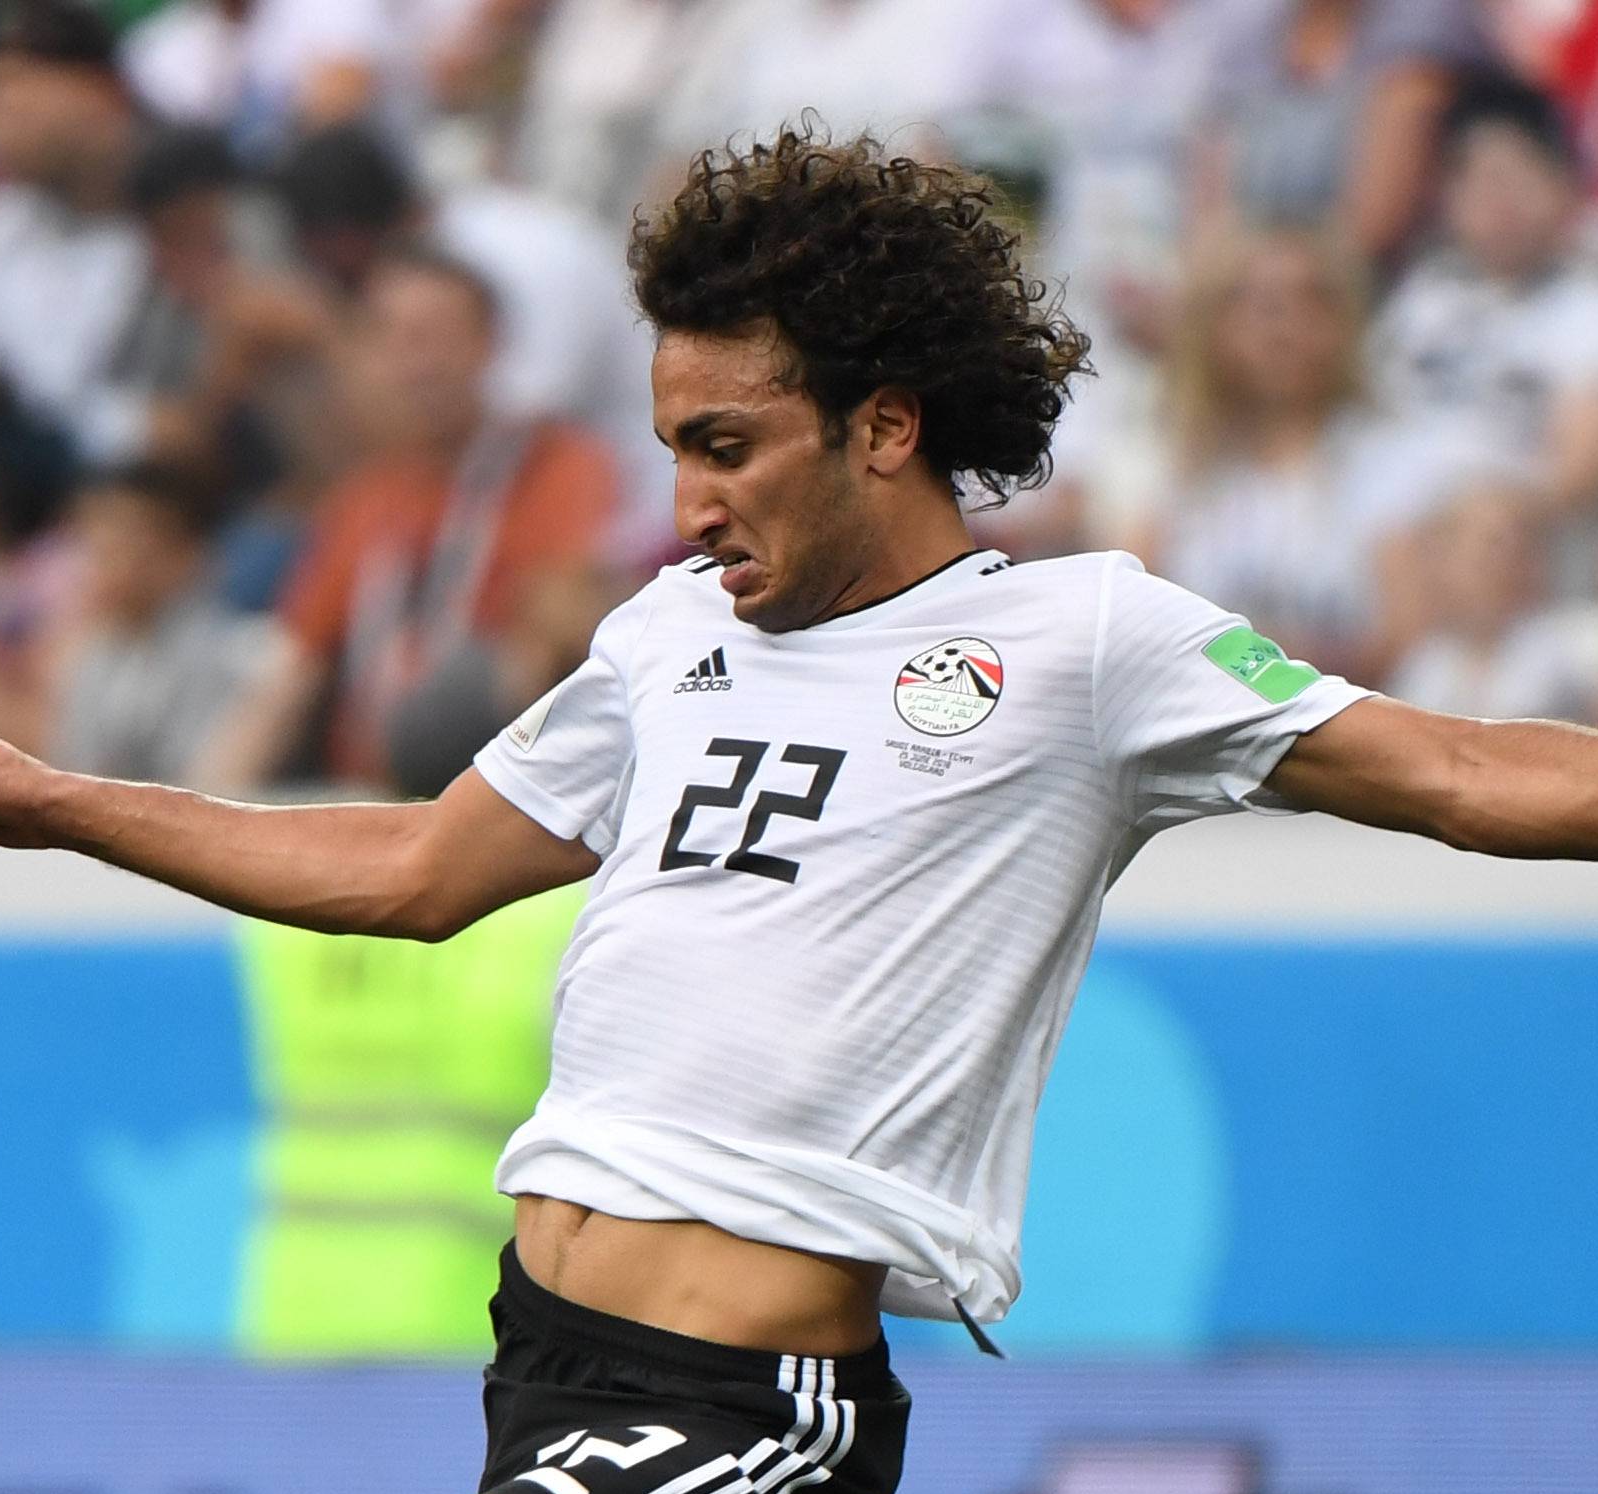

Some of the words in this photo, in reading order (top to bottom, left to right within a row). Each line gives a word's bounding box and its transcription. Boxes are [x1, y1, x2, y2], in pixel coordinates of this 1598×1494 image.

[673, 675, 733, 694] adidas
[907, 711, 948, 730] EGYPTIAN
[660, 737, 847, 884] 22
